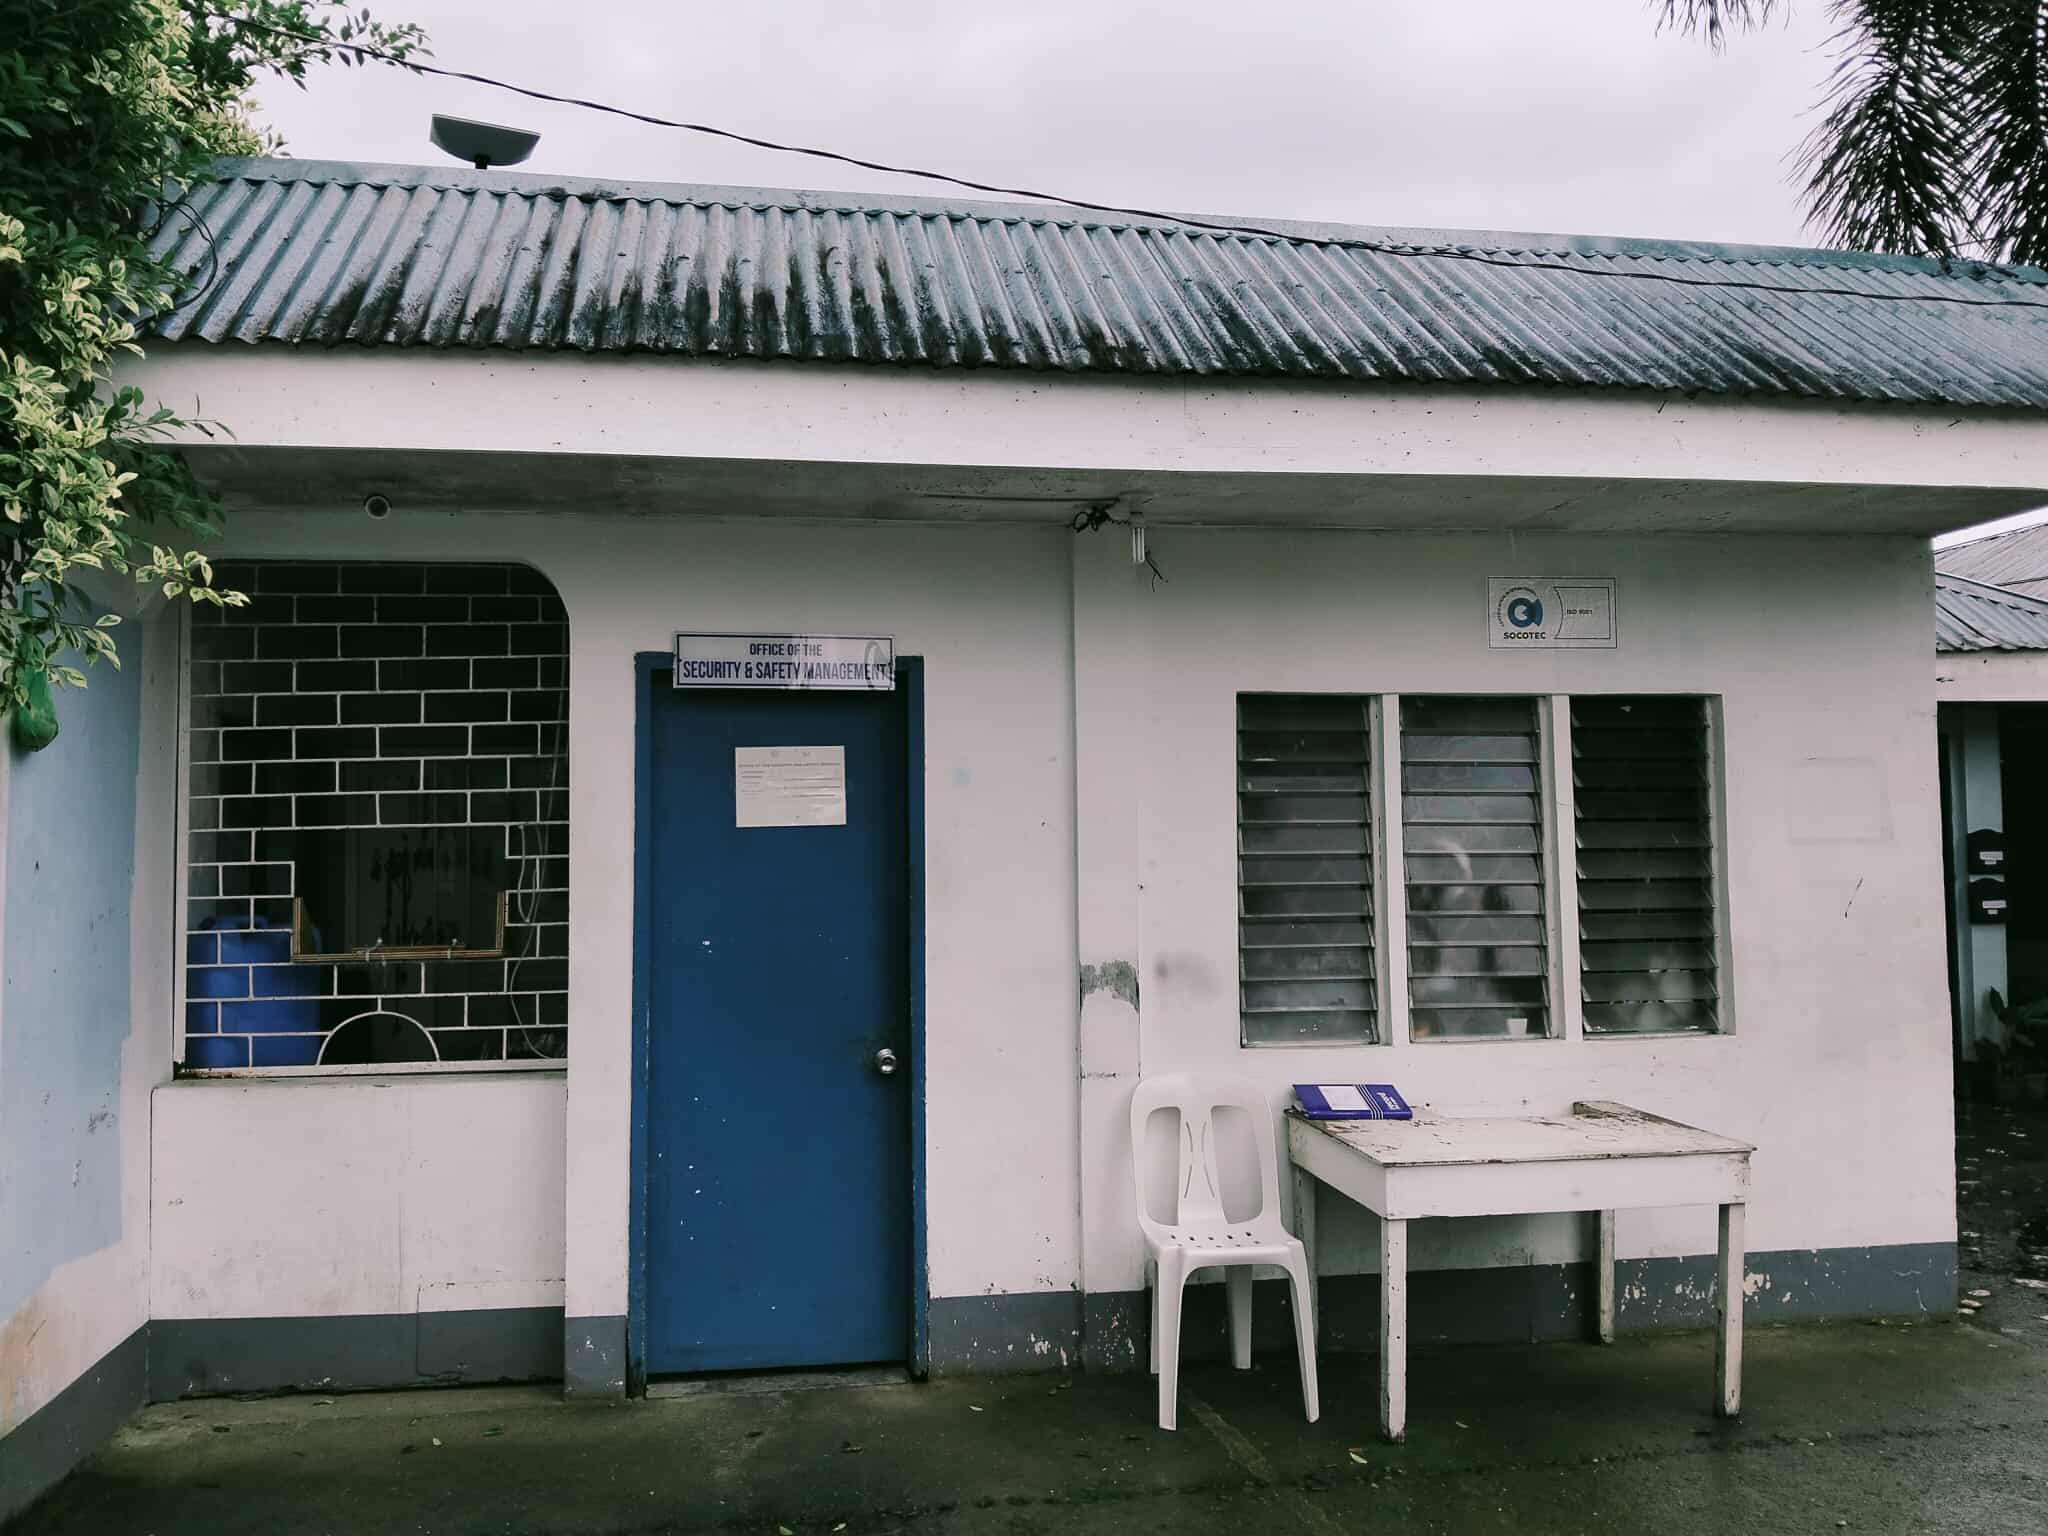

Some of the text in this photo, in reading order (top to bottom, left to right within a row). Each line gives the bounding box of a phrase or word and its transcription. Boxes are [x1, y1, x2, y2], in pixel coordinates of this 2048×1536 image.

[1503, 632, 1546, 640] SOCOTEC
[749, 643, 823, 657] OFFICE OF THE
[683, 660, 888, 681] SECURITY & SAFETY MANAGEMENT
